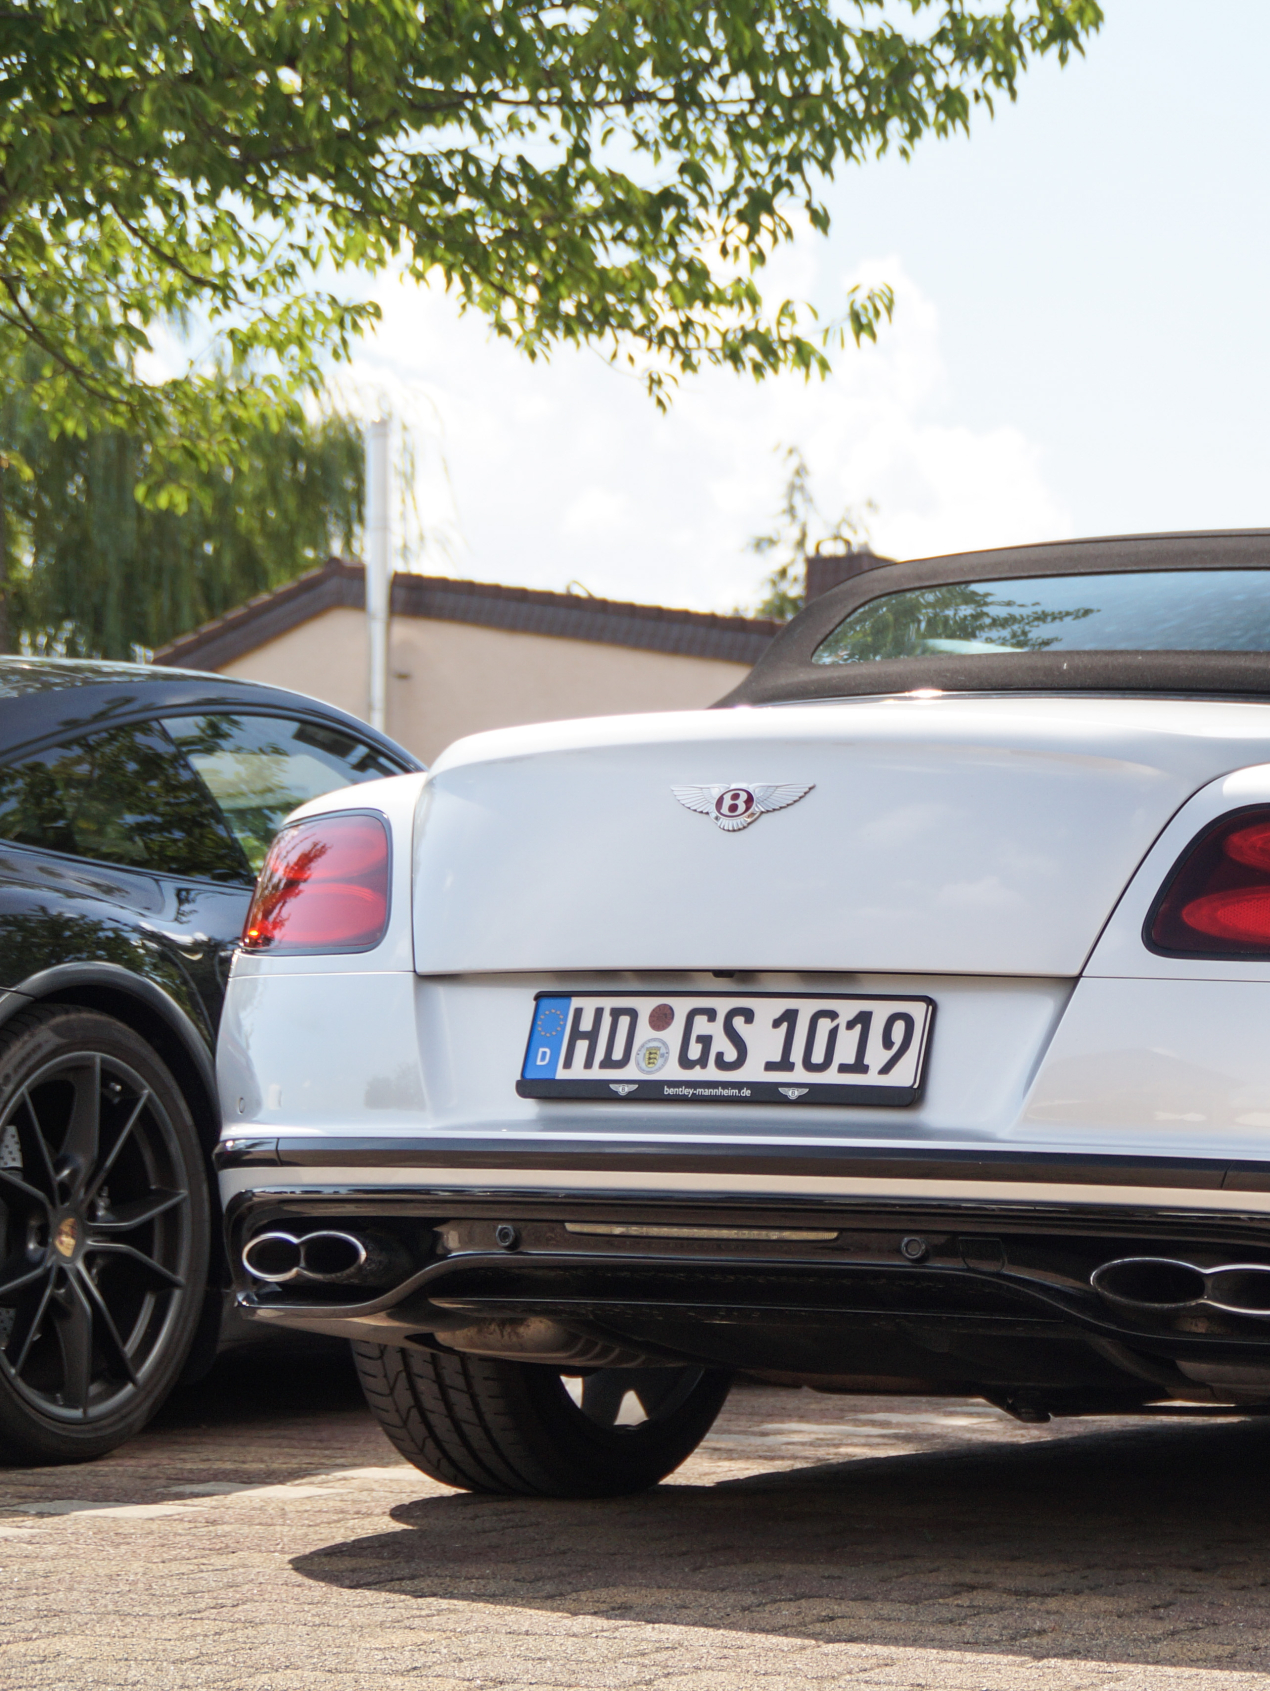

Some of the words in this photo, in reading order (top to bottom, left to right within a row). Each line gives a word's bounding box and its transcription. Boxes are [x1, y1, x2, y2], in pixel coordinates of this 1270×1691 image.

[562, 1007, 639, 1070] HD
[678, 1007, 755, 1072] GS
[763, 1008, 915, 1075] 1019
[536, 1047, 550, 1066] D
[663, 1085, 752, 1098] bentley-mannheim.de
